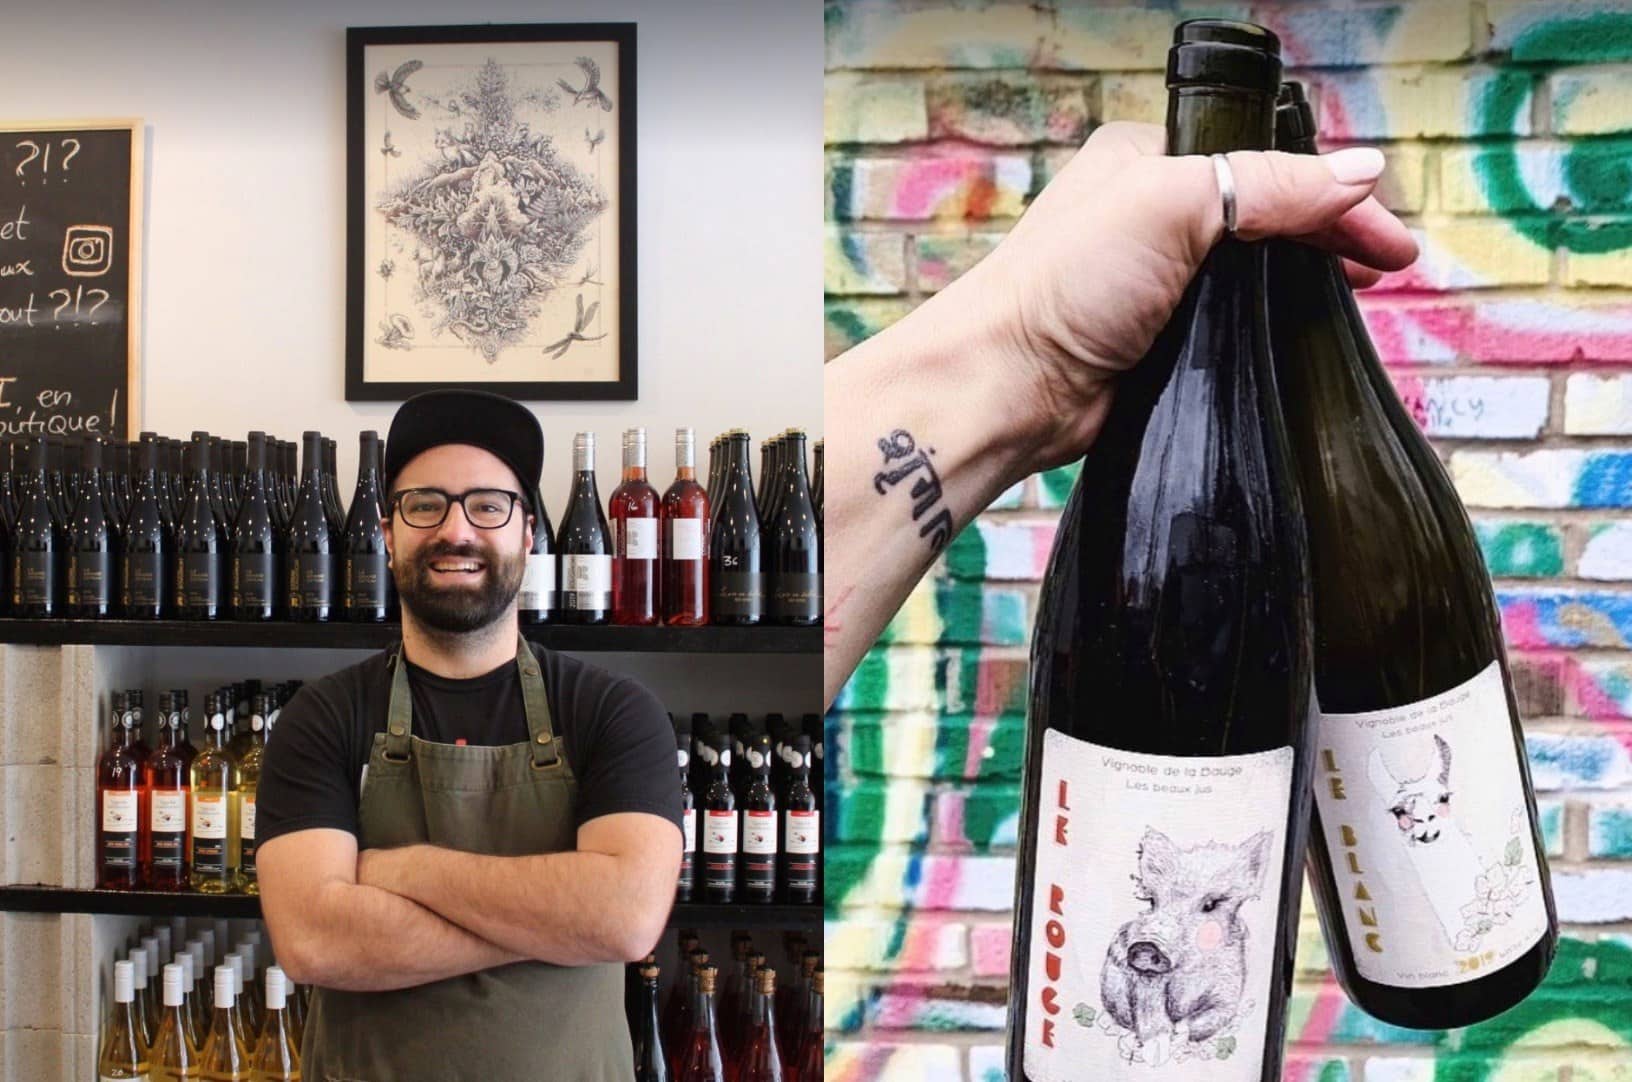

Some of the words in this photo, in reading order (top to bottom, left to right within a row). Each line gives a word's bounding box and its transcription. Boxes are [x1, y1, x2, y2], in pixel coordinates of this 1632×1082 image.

[0, 204, 30, 240] et
[36, 389, 72, 408] en
[1101, 756, 1158, 776] Vignoble
[1163, 766, 1181, 777] de
[1184, 767, 1198, 777] la
[1126, 778, 1149, 791] Les
[1152, 783, 1193, 794] beaux
[1194, 783, 1213, 795] jus
[1323, 749, 1346, 800] LE
[1055, 779, 1071, 847] LE
[1340, 824, 1383, 953] BLANC
[1041, 883, 1066, 1050] ROUGE
